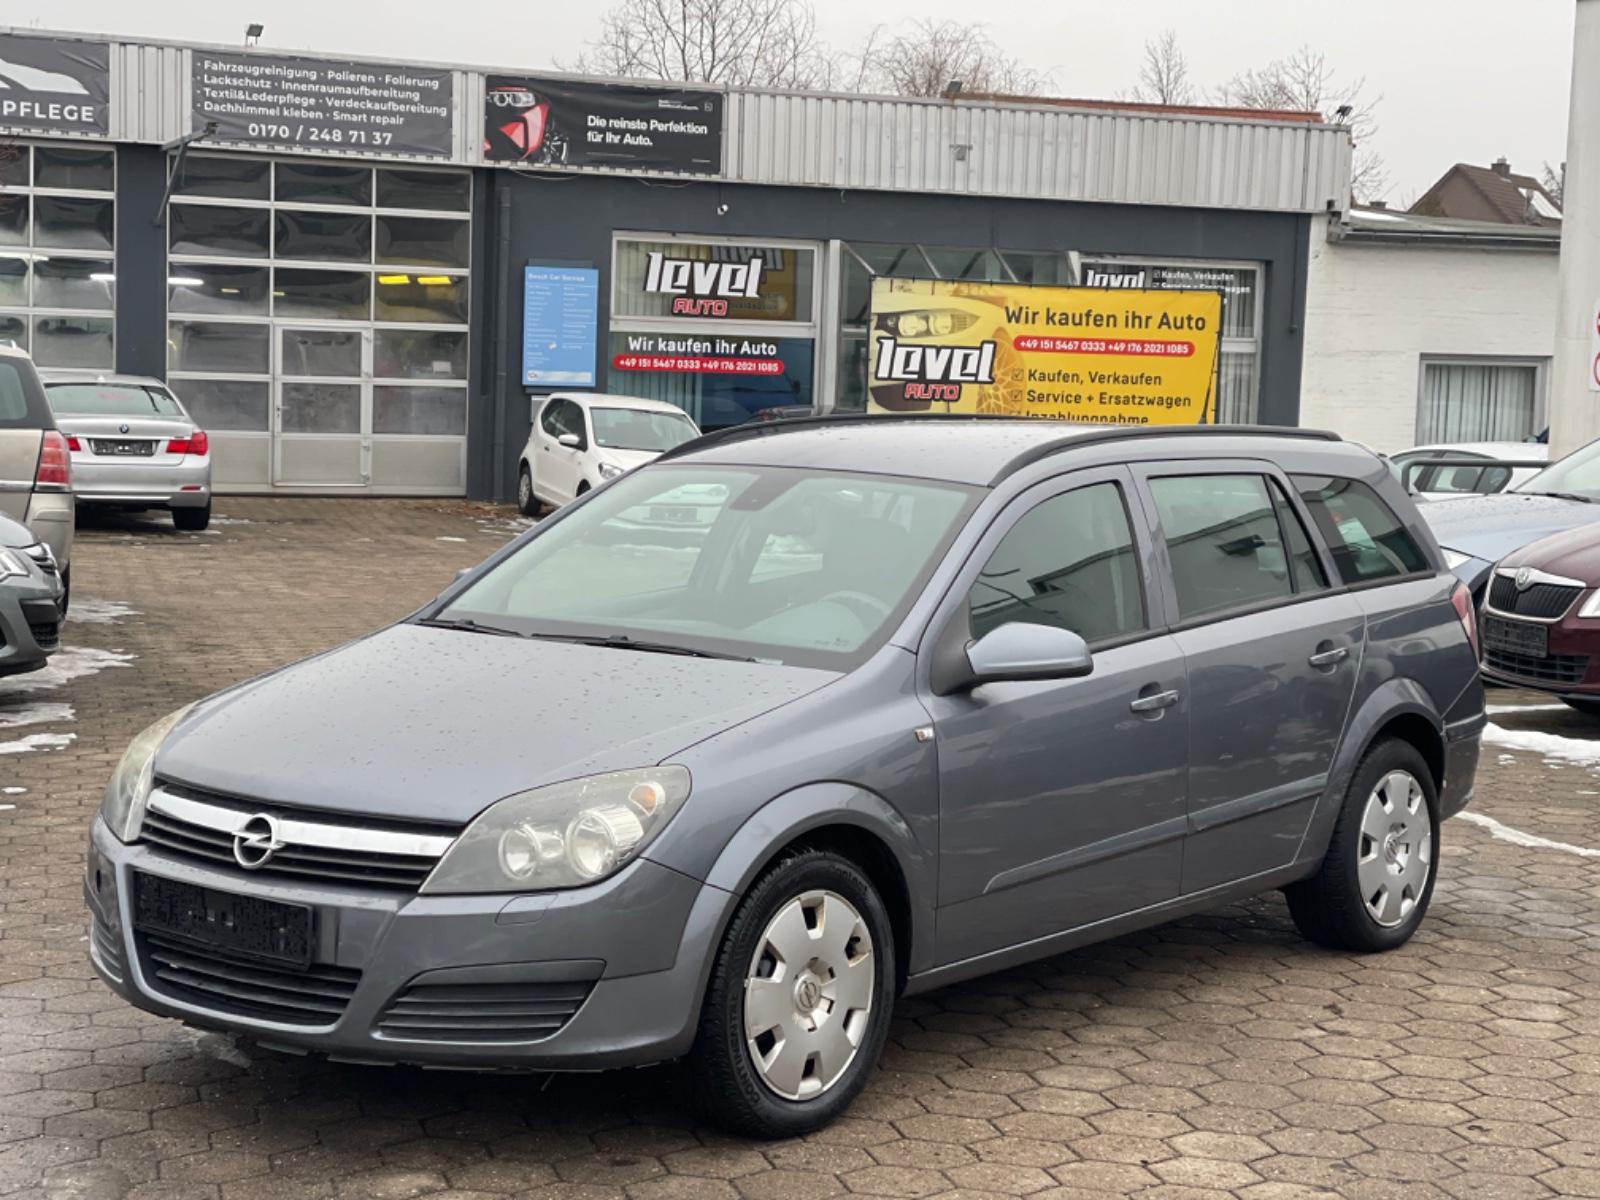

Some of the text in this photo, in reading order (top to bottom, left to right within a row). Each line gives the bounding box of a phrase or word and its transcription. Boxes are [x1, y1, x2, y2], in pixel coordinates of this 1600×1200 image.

[204, 60, 439, 90] Fahrzeugreinigung Polieren Folierung
[204, 74, 420, 102] Lackschutz Innenraumaufbereitung
[3, 100, 94, 122] PFLEGE
[203, 87, 447, 117] Textil&Lederpflege Verdeckaufbereitung
[204, 101, 405, 126] Dachhimmel kleben Smart repair
[248, 123, 393, 145] 0170 / 248 71 37
[587, 115, 708, 135] Die reinste Perfektion
[586, 131, 654, 146] für Ihr Auto.
[645, 252, 763, 298] level
[673, 297, 728, 317] AUTO
[1004, 306, 1206, 331] Wir kaufen ihr Auto
[628, 336, 777, 356] Wir kaufen ihr Auto
[1020, 339, 1038, 349] +49
[1040, 339, 1053, 349] 151
[1055, 340, 1079, 350] 5467
[1081, 341, 1105, 351] 0333
[1108, 342, 1126, 352] +49
[1128, 343, 1142, 353] 176
[1144, 343, 1164, 353] 2021
[620, 358, 637, 367] +49
[639, 358, 652, 368] 151
[653, 358, 675, 368] 5467
[677, 359, 701, 369] 0333
[703, 361, 719, 370] +49
[736, 362, 756, 371] 2021
[877, 339, 995, 382] level
[1028, 369, 1162, 385] Kaufen, Verkaufen
[905, 383, 960, 400] AUTO
[1027, 390, 1082, 404] Service
[1099, 392, 1192, 409] Ersatzwagen
